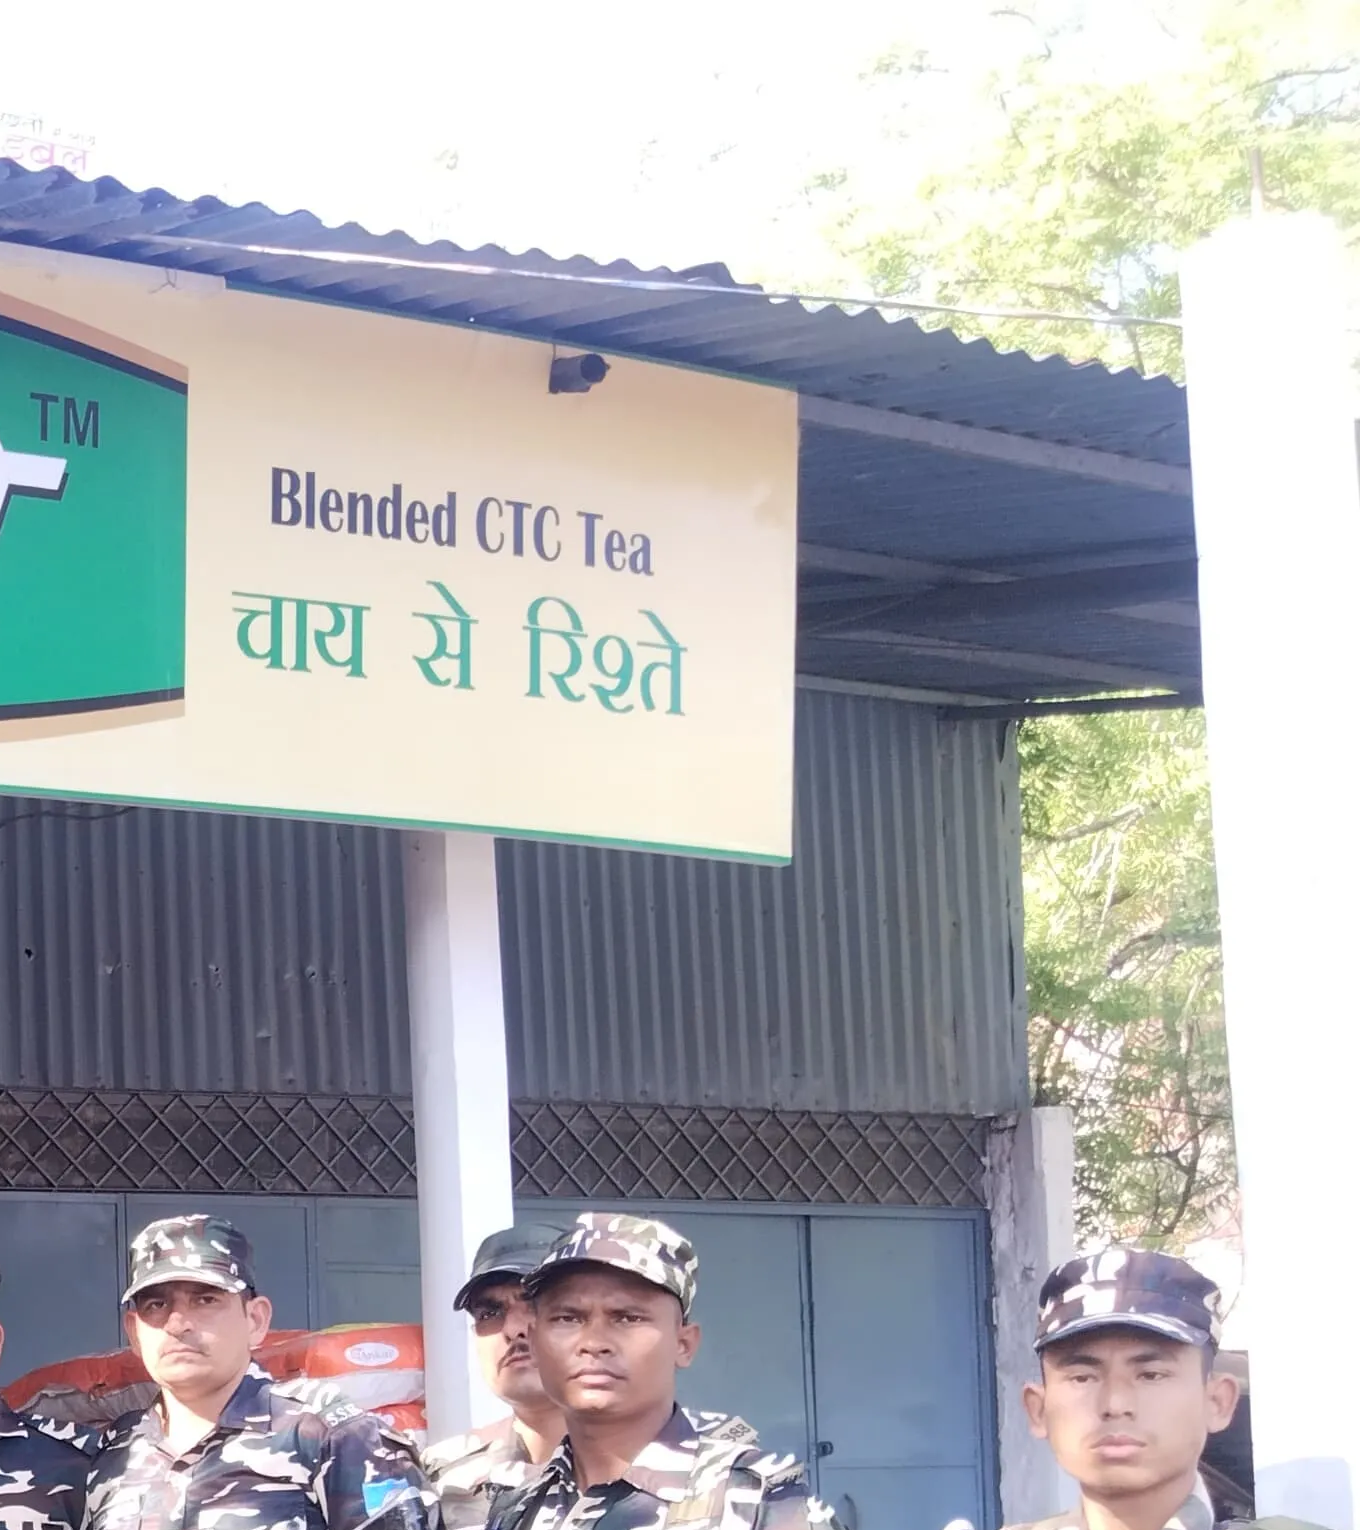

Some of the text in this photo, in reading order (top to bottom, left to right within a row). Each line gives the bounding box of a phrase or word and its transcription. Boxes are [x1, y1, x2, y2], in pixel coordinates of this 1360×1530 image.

[29, 393, 101, 449] TM
[271, 466, 654, 576] Blended CTC Tea
[232, 580, 688, 716] चाय से रिश्ते
